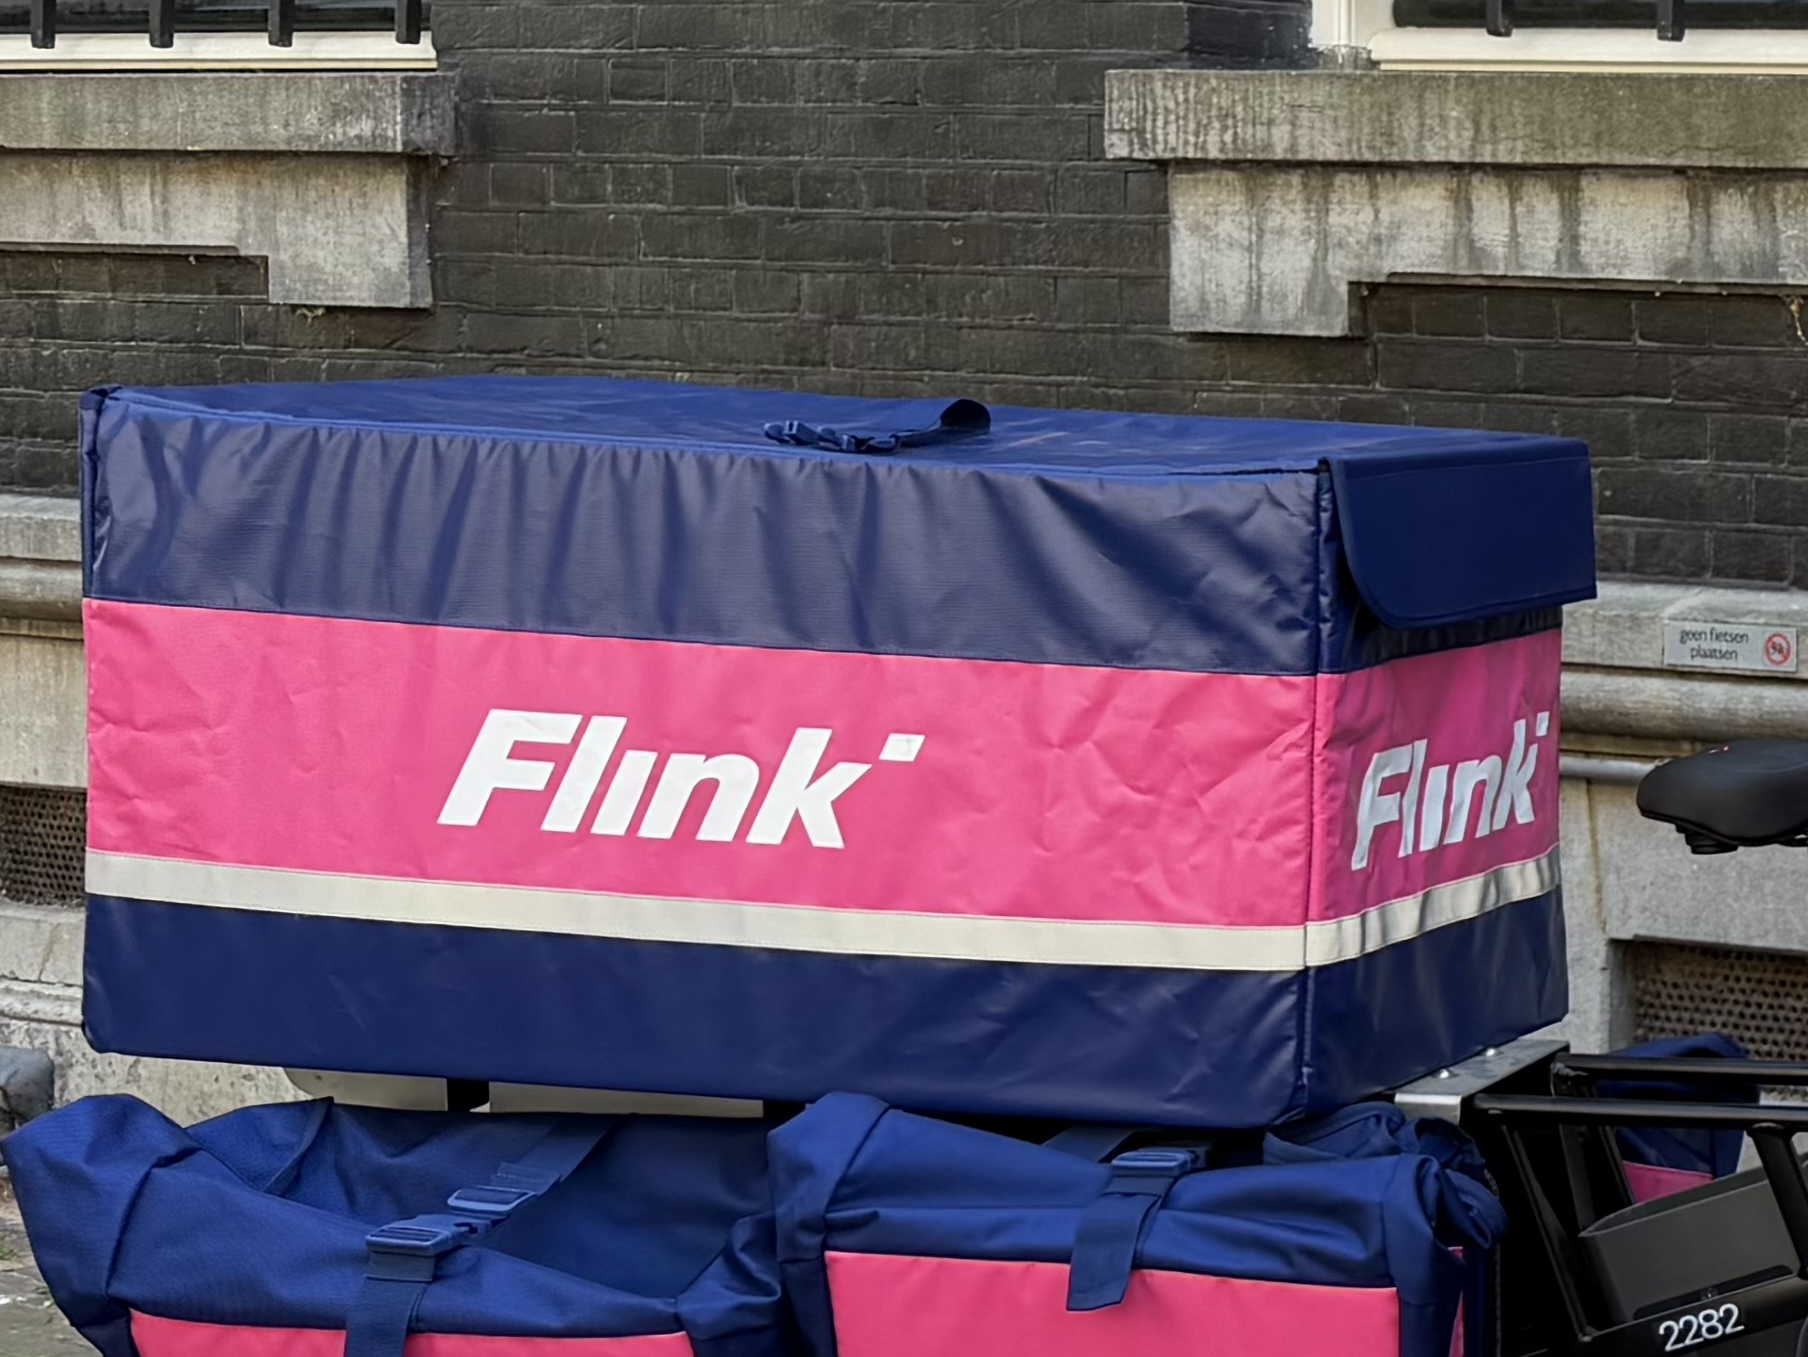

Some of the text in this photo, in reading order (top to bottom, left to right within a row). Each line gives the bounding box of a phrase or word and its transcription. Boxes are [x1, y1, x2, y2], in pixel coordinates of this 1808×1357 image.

[1690, 645, 1738, 660] plaatsen
[1709, 627, 1750, 644] fietsen
[437, 709, 925, 850] Flink
[1351, 710, 1550, 872] Flink
[1658, 1303, 1745, 1352] 2282
